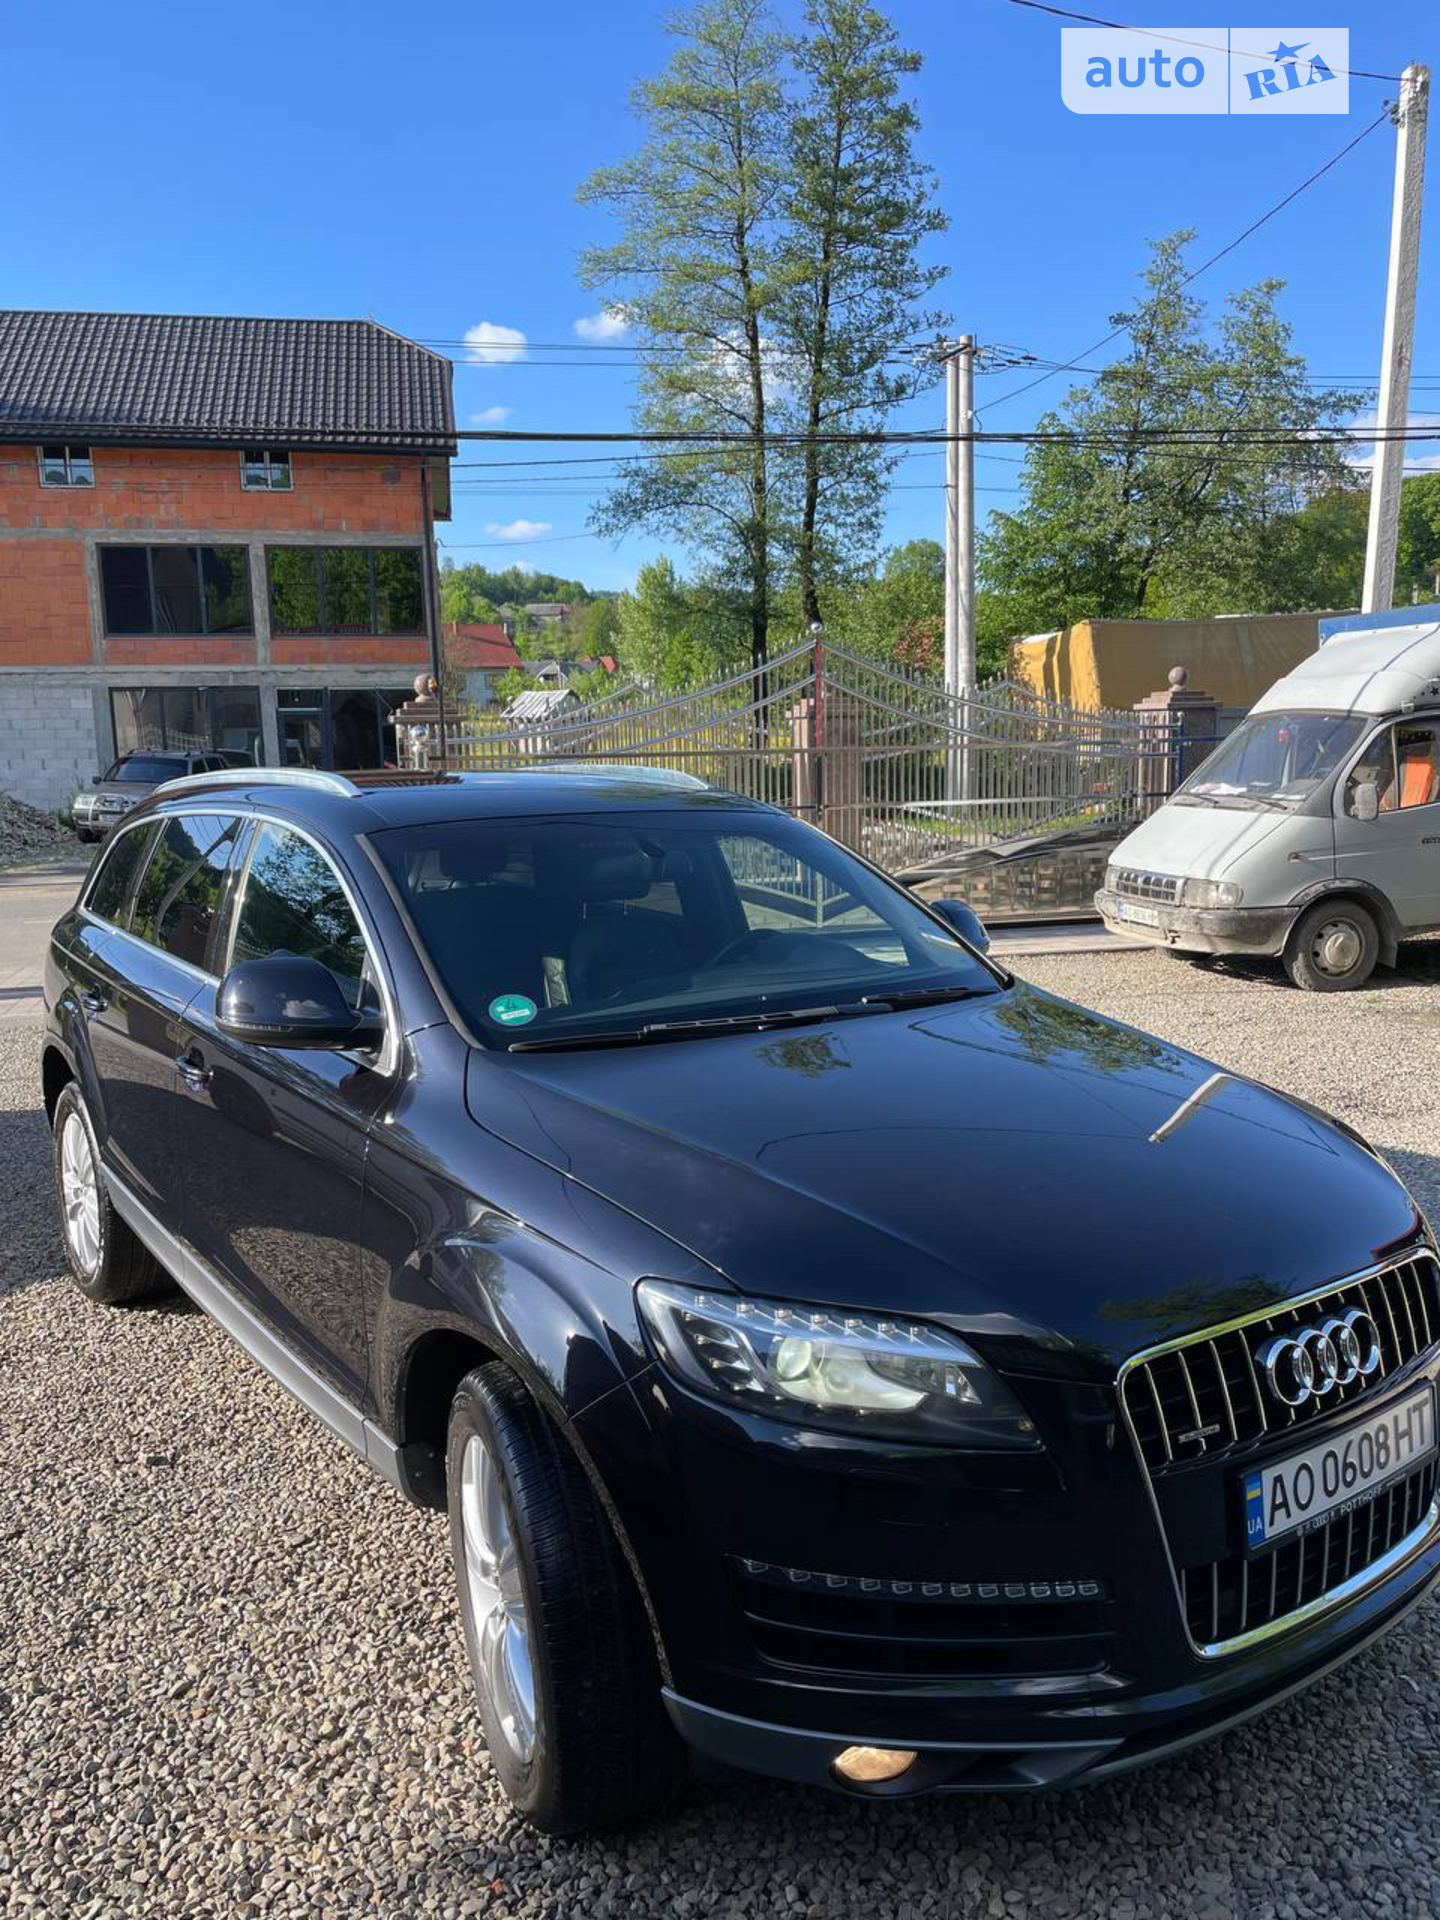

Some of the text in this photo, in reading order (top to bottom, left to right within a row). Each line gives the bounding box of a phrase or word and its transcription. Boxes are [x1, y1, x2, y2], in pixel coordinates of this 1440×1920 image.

[1269, 1397, 1429, 1527] AO 0608 HT
[1248, 1516, 1263, 1534] UA
